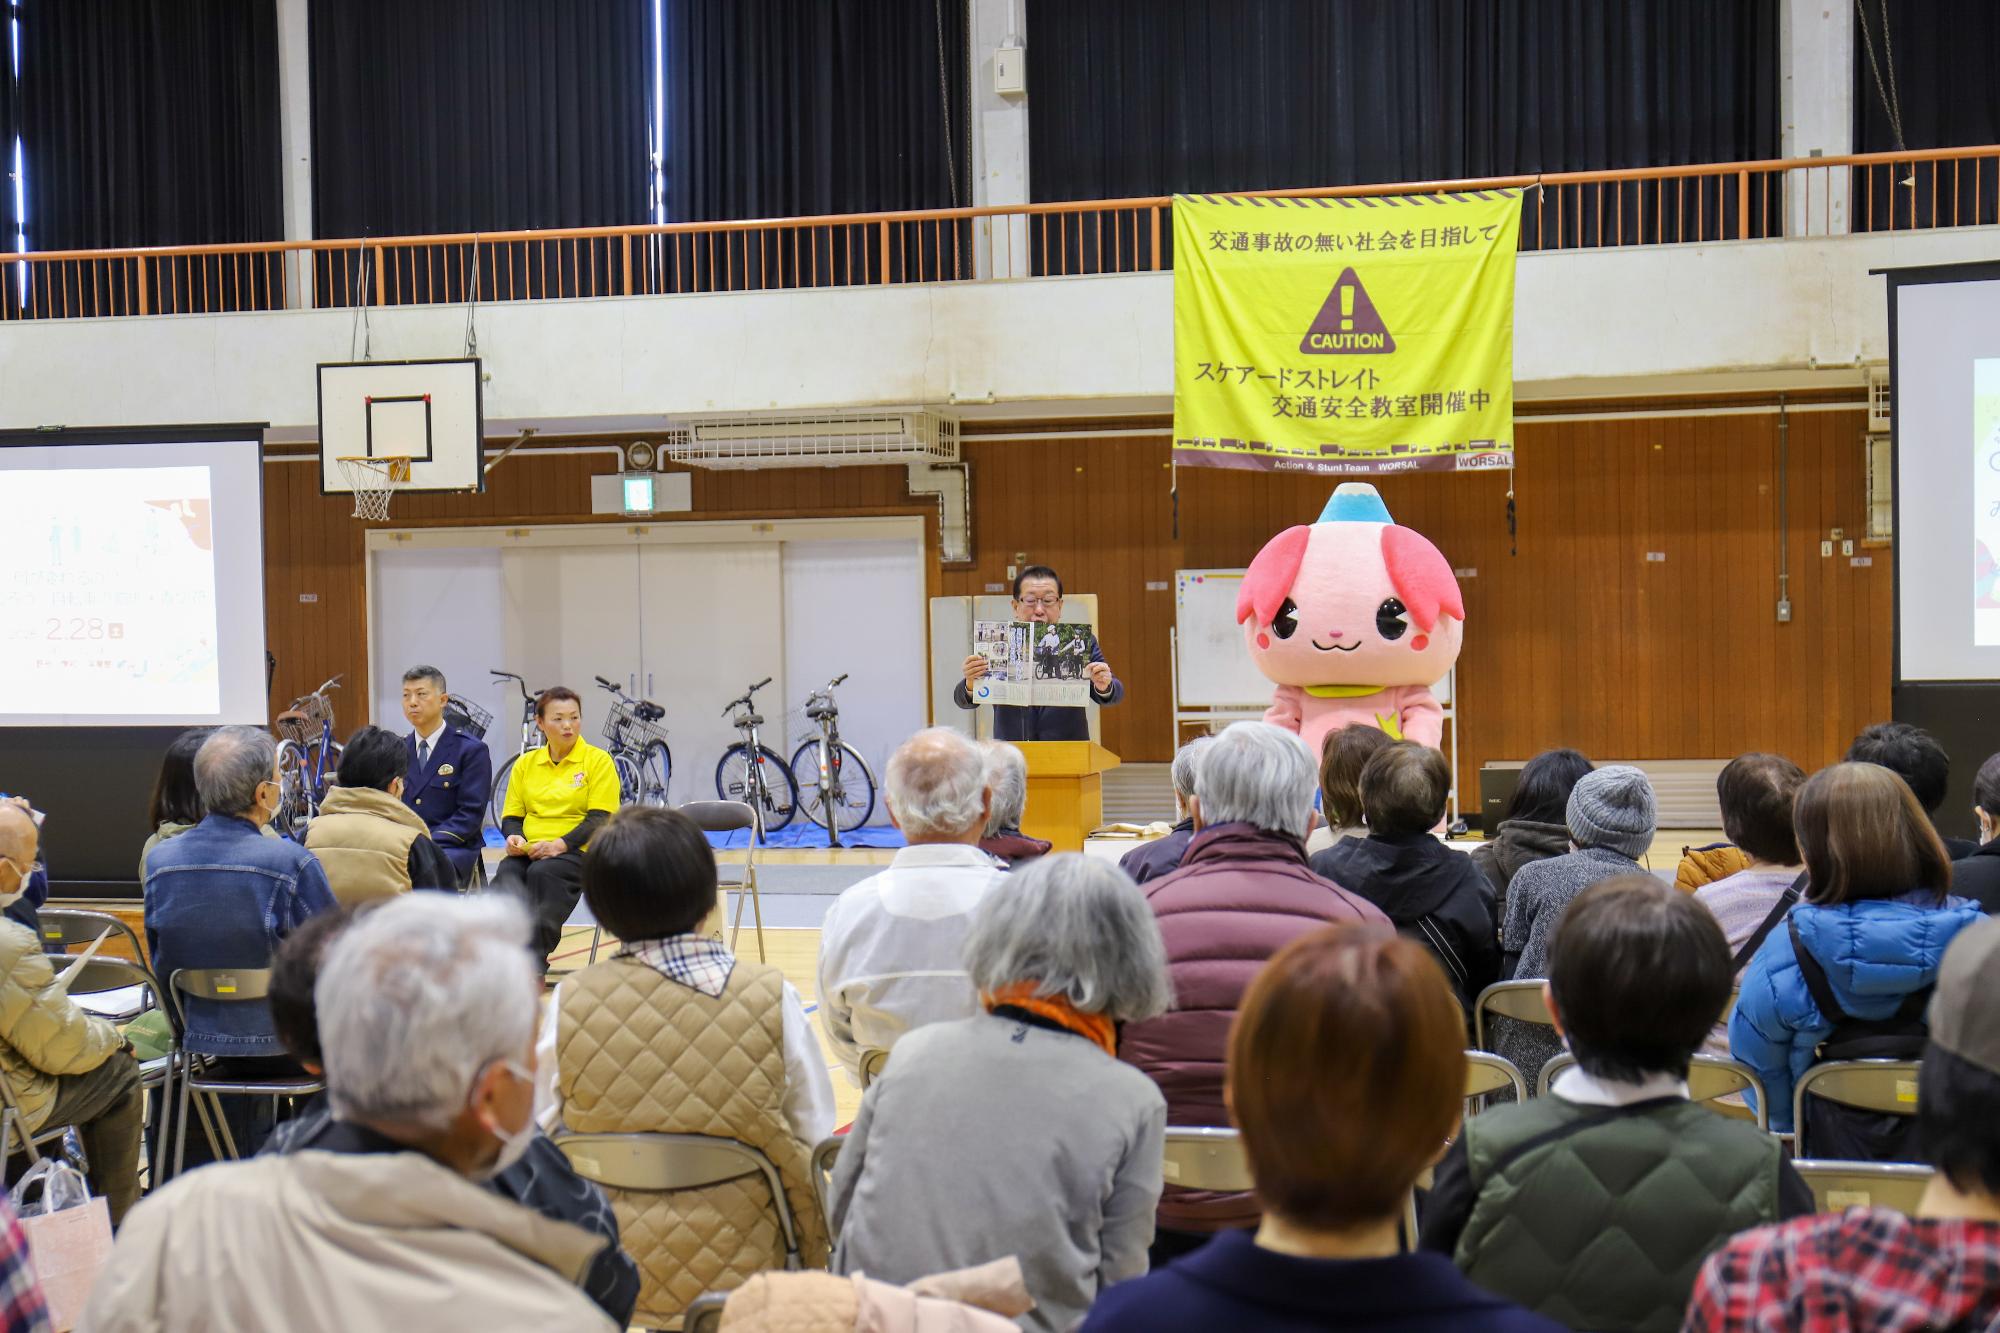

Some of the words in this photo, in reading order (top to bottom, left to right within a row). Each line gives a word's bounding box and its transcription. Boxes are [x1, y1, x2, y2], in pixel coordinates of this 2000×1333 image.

[1209, 225, 1498, 252] 交通事故の無い社会を目指して
[1309, 333, 1385, 350] CAUTION
[1194, 361, 1381, 389] スケアードストレイト
[1271, 388, 1491, 419] 交通安全教室開催中
[1274, 460, 1304, 470] Action
[1307, 462, 1314, 470] &
[1317, 463, 1342, 473] Stunt
[1344, 463, 1370, 472] Team
[1378, 460, 1419, 471] WORSAL
[1458, 454, 1513, 468] WORSAL
